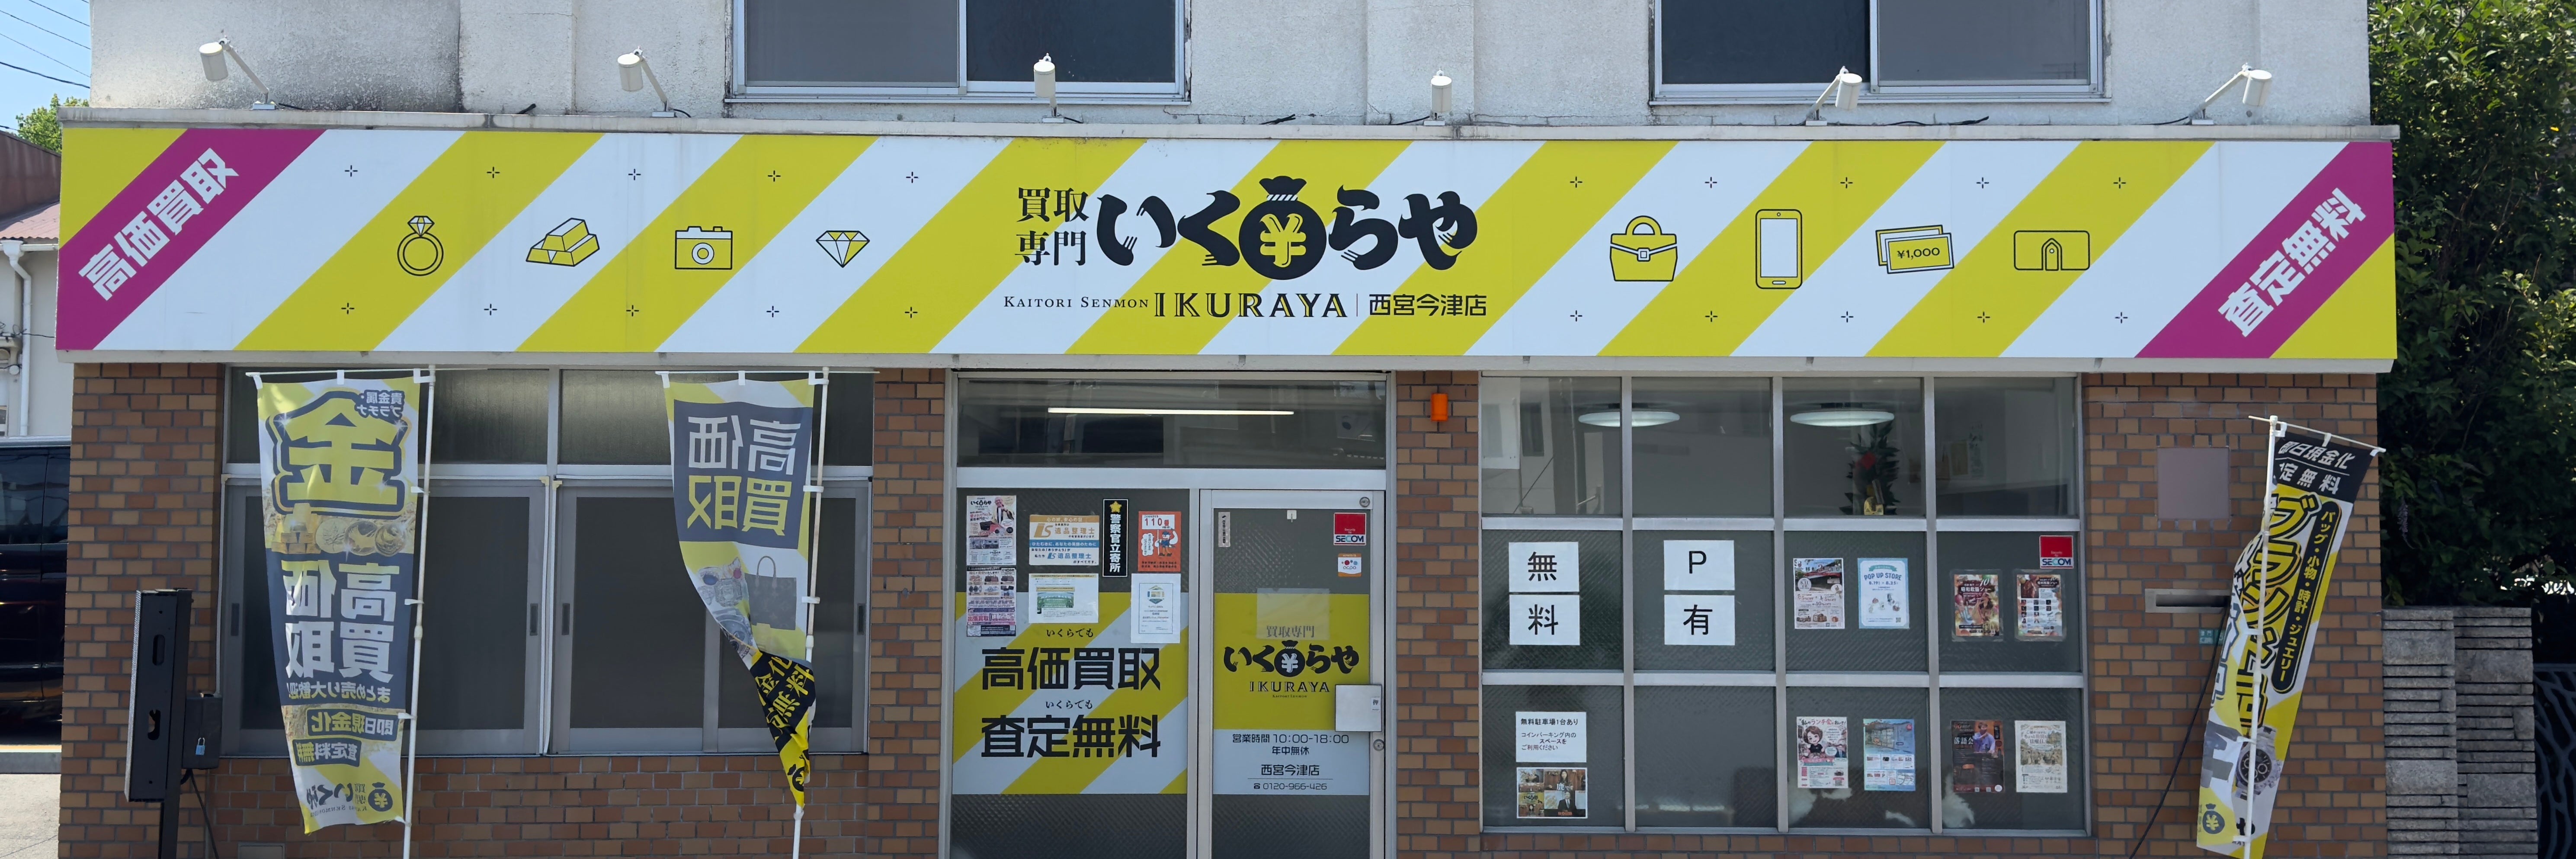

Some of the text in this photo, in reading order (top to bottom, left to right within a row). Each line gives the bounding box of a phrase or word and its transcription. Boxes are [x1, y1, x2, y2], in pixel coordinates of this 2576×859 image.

[1017, 187, 1089, 223] 買取
[78, 148, 239, 301] 高価買取
[1014, 231, 1087, 267] 専門
[1897, 247, 1940, 260] ¥1,000
[2218, 188, 2366, 337] 査定無料
[1003, 293, 1348, 318] KAITORI SENMON IKURAYA
[1369, 294, 1487, 317] 西宮今津店
[1109, 513, 1121, 573] 警察官立寄所
[1046, 628, 1094, 638] いくらでも
[1266, 625, 1315, 638] 買取専門
[982, 647, 1161, 691] 高価買取
[1250, 681, 1330, 692] IKURAYA
[1045, 699, 1093, 709] いくらでも
[981, 714, 1161, 758] 査定無料
[1232, 734, 1349, 744] 営業時間 10:00-18:00
[1272, 746, 1310, 756] 年中無休
[1261, 764, 1320, 776] 西宮今津店
